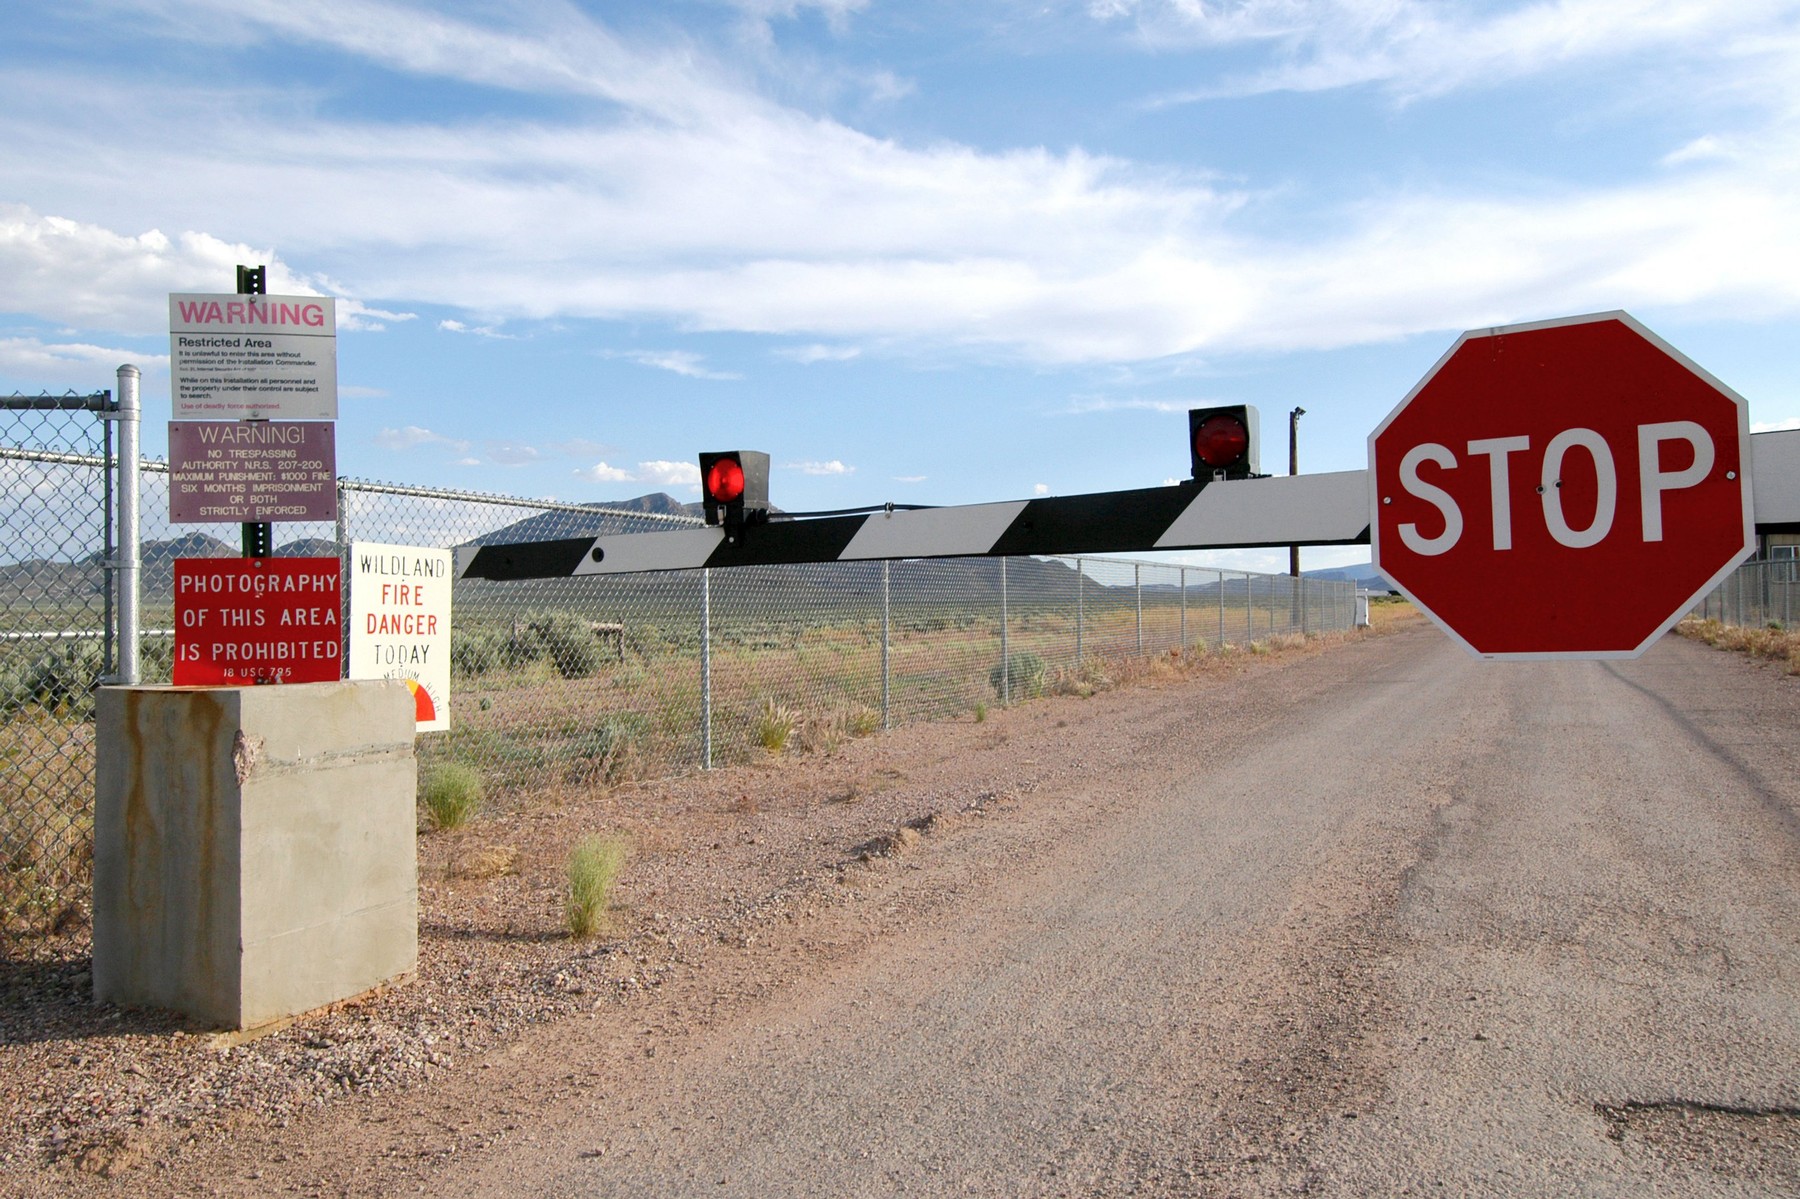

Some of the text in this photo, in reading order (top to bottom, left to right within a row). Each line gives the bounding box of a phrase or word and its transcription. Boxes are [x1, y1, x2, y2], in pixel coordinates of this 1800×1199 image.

[178, 301, 324, 327] WARNING
[179, 338, 272, 348] Restricted Area
[295, 386, 318, 394] subject
[198, 427, 305, 444] WARNING!
[208, 450, 296, 459] NO TRESPASSING
[182, 461, 322, 470] AUTHORITY N.R.S. 207-200
[173, 472, 331, 481] MAXIMUM PUNISHMENT: $1000 FINE
[181, 483, 323, 492] SIX MONTHS IMPRISONMENT
[1397, 420, 1716, 556] STOP
[230, 495, 277, 504] OR BOTH
[200, 506, 307, 515] STRICTLY ENFORCED
[361, 554, 444, 578] WILDLAND
[181, 574, 337, 593] PHOTOGRAPHY
[382, 584, 423, 605] FIRE
[183, 608, 337, 627] OF THIS AREA
[367, 613, 437, 635] DANGER
[181, 641, 338, 661] IS PROHIBITED
[374, 644, 430, 665] TODAY
[224, 668, 234, 677] 18
[241, 668, 264, 677] USC
[383, 668, 420, 681] MEDIUM
[426, 682, 442, 712] HIGH
